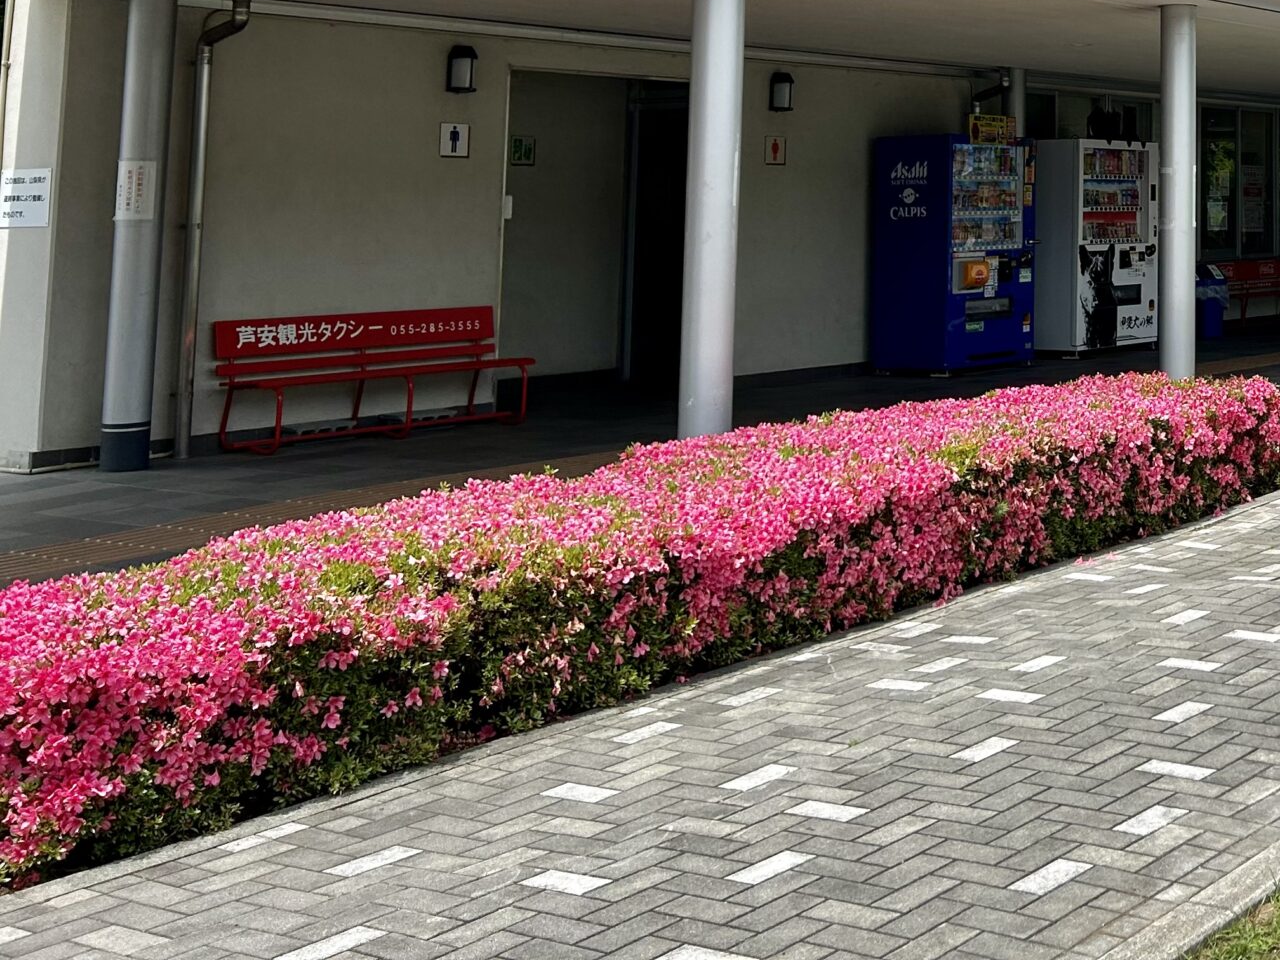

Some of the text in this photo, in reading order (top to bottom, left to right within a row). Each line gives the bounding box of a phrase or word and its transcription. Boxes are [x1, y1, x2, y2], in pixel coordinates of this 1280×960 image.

[890, 160, 928, 179] Asahi
[890, 206, 927, 220] CALPIS
[235, 319, 481, 349] 芦安観光タクシー 055-285-3555
